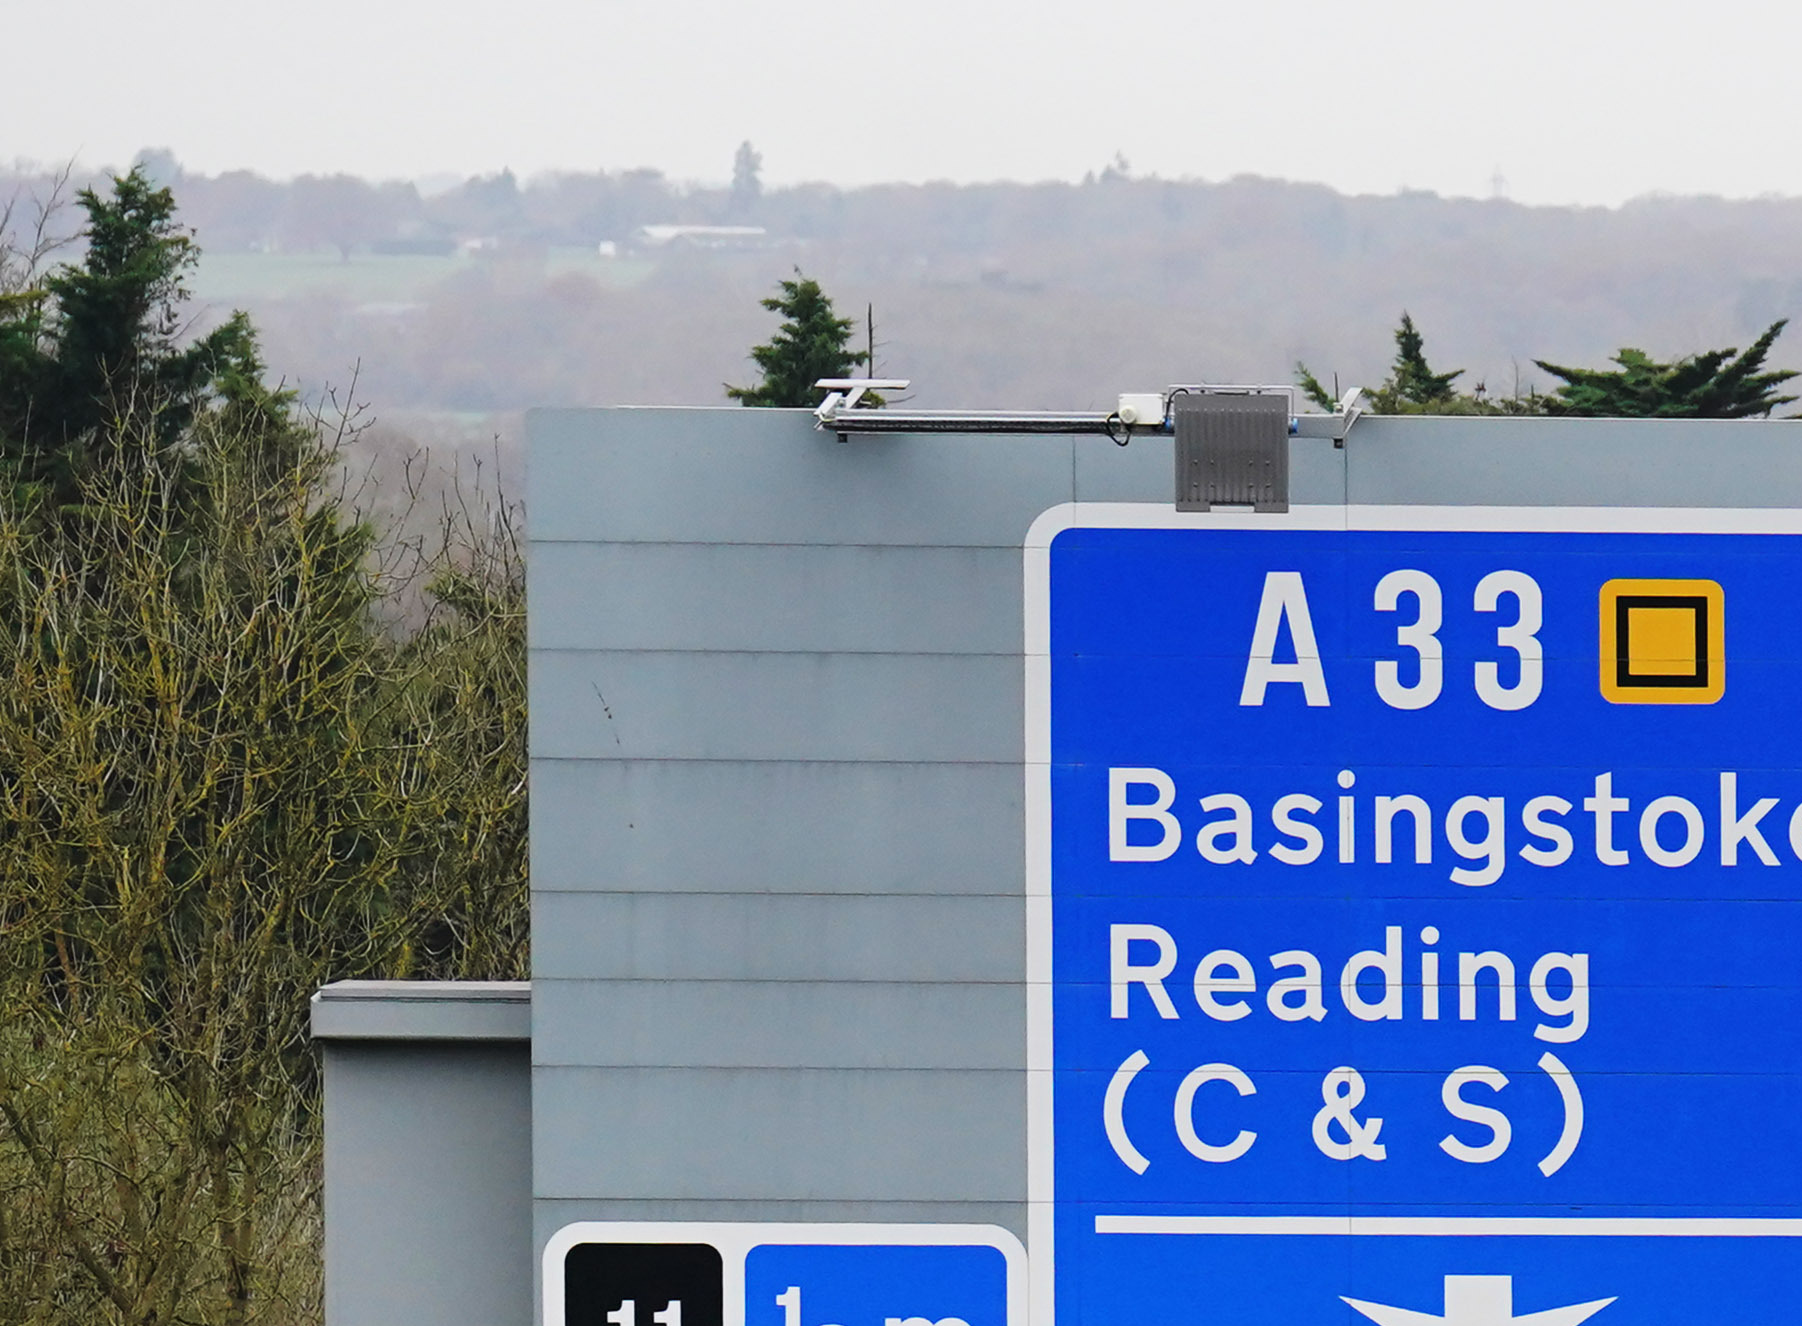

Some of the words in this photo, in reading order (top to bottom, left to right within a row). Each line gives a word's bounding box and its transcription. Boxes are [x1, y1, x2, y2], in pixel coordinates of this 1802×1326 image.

[1110, 924, 1589, 1044] Reading
[1103, 1049, 1257, 1175] (C
[1312, 1066, 1387, 1161] &
[1439, 1052, 1584, 1178] S)
